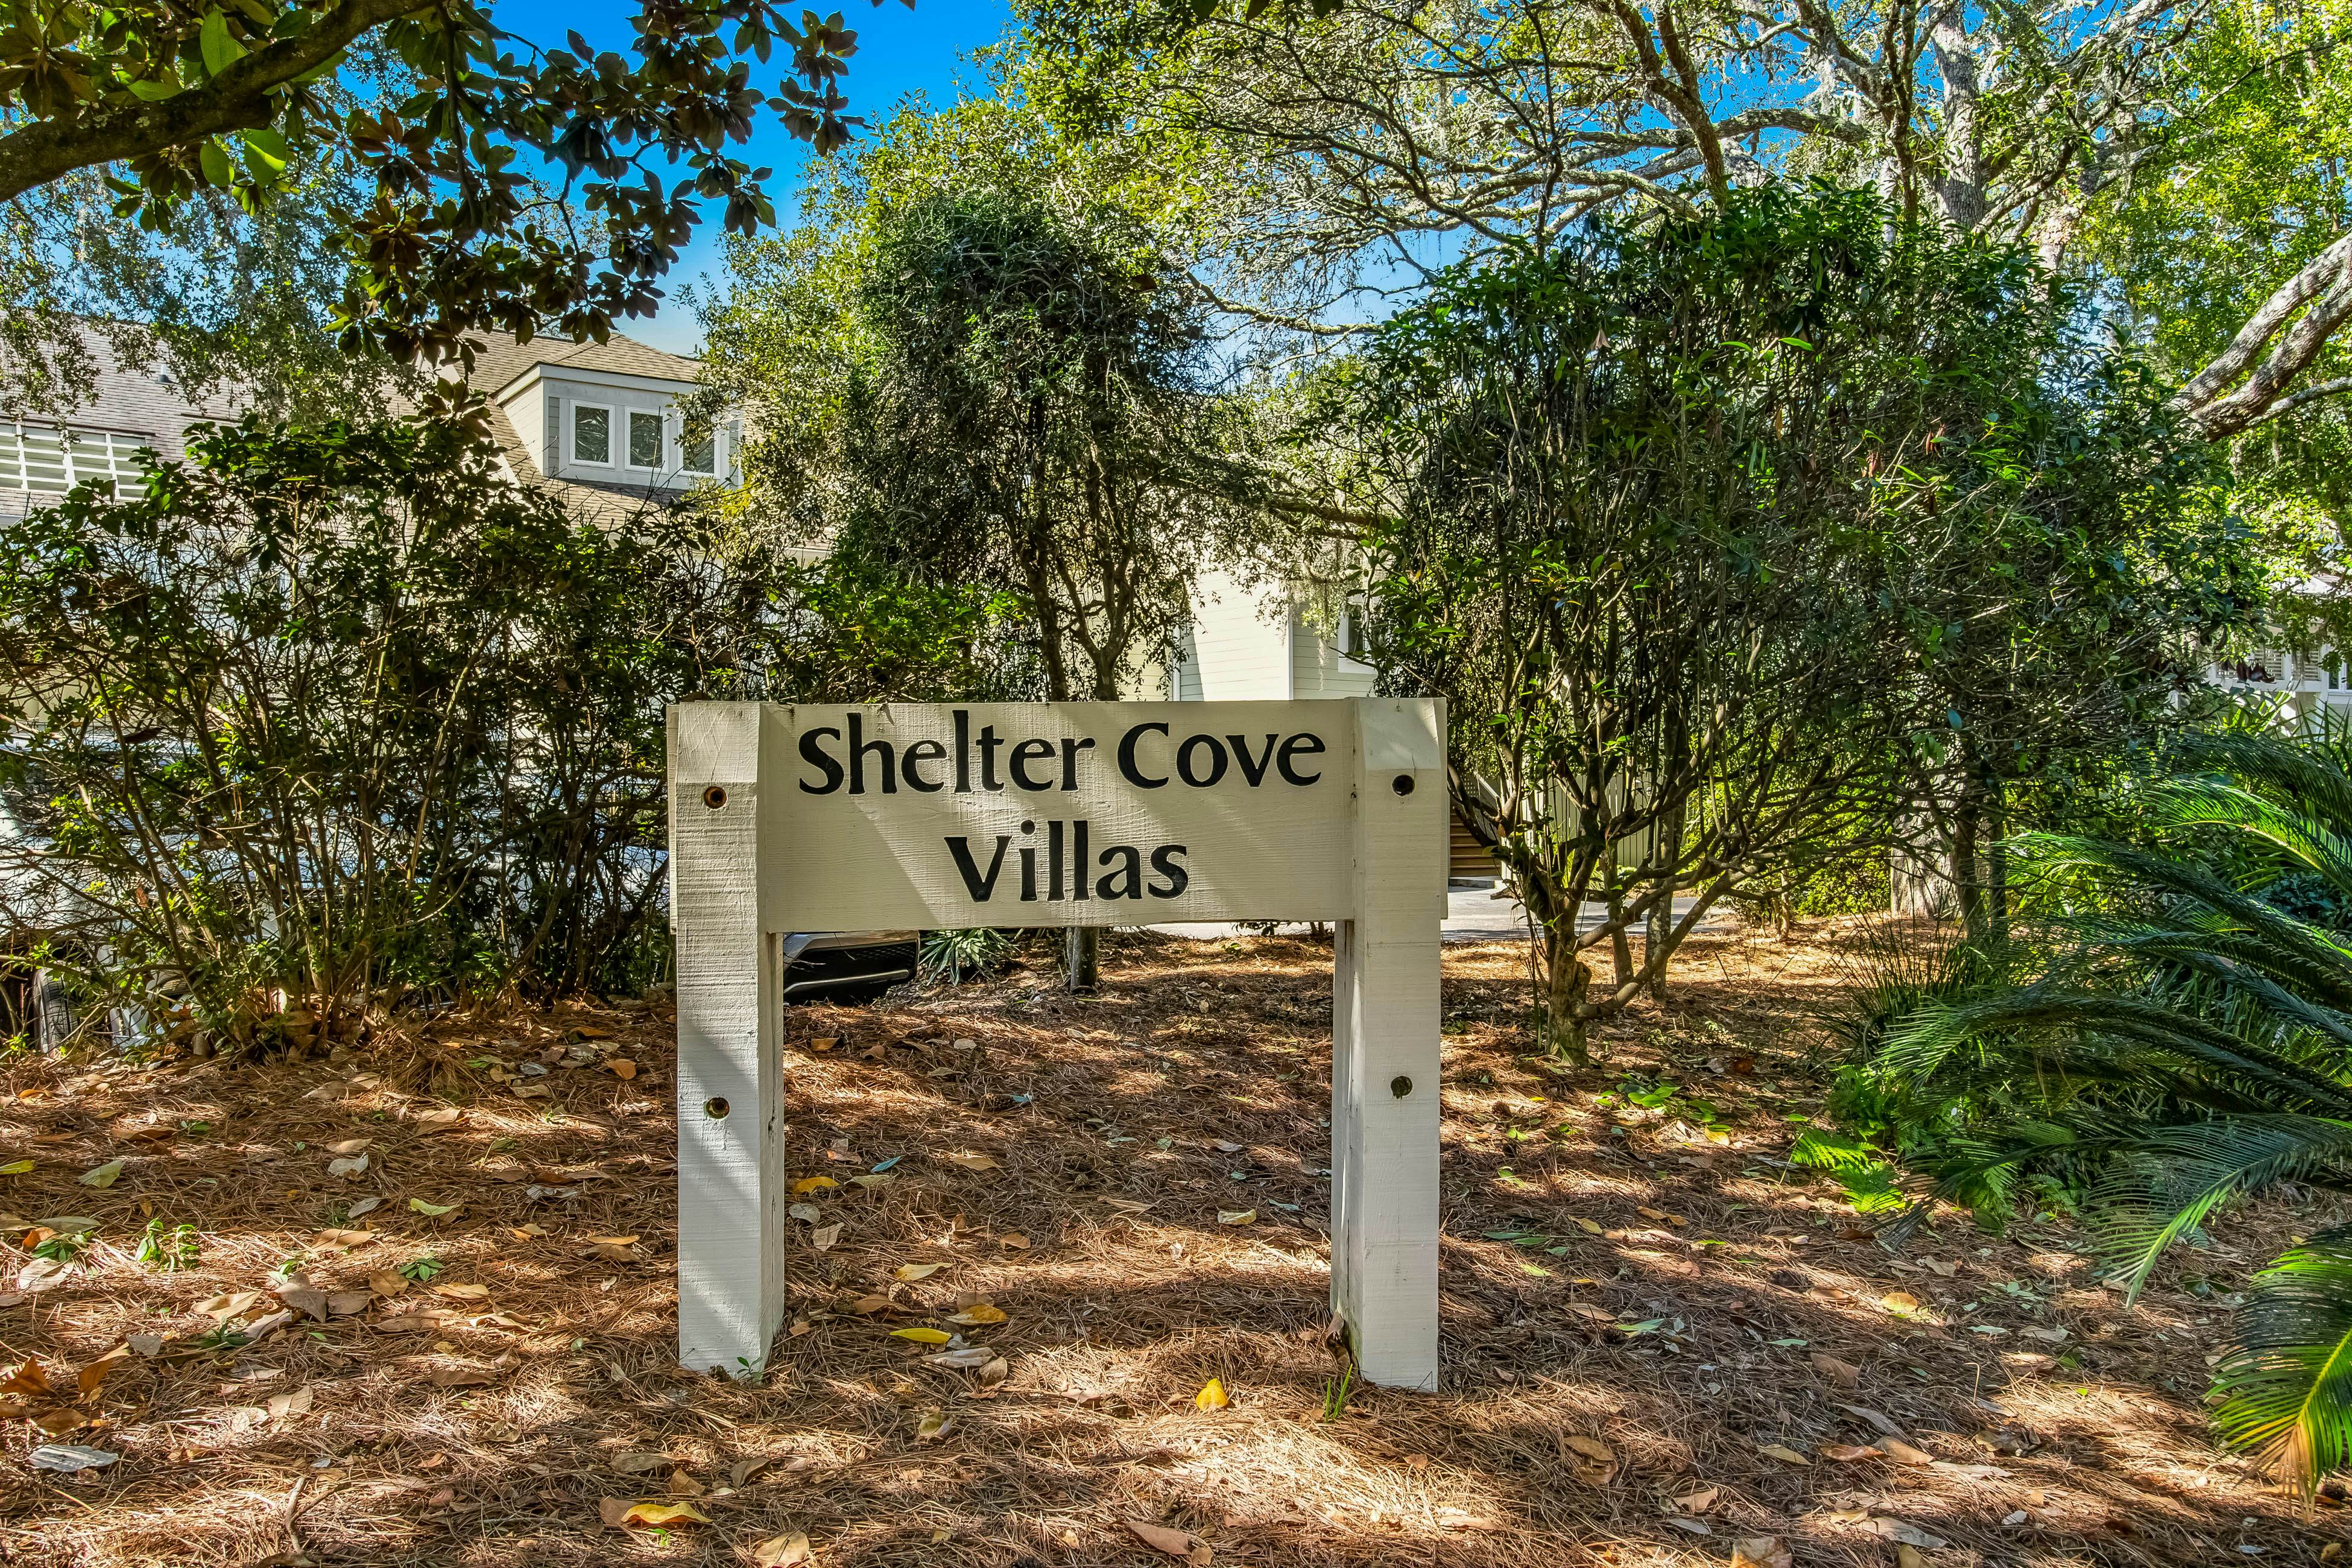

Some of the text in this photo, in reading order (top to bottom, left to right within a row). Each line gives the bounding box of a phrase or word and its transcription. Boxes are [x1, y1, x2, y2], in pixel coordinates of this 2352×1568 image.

[798, 710, 1326, 795] Shelter Cove
[943, 820, 1189, 903] Villas
